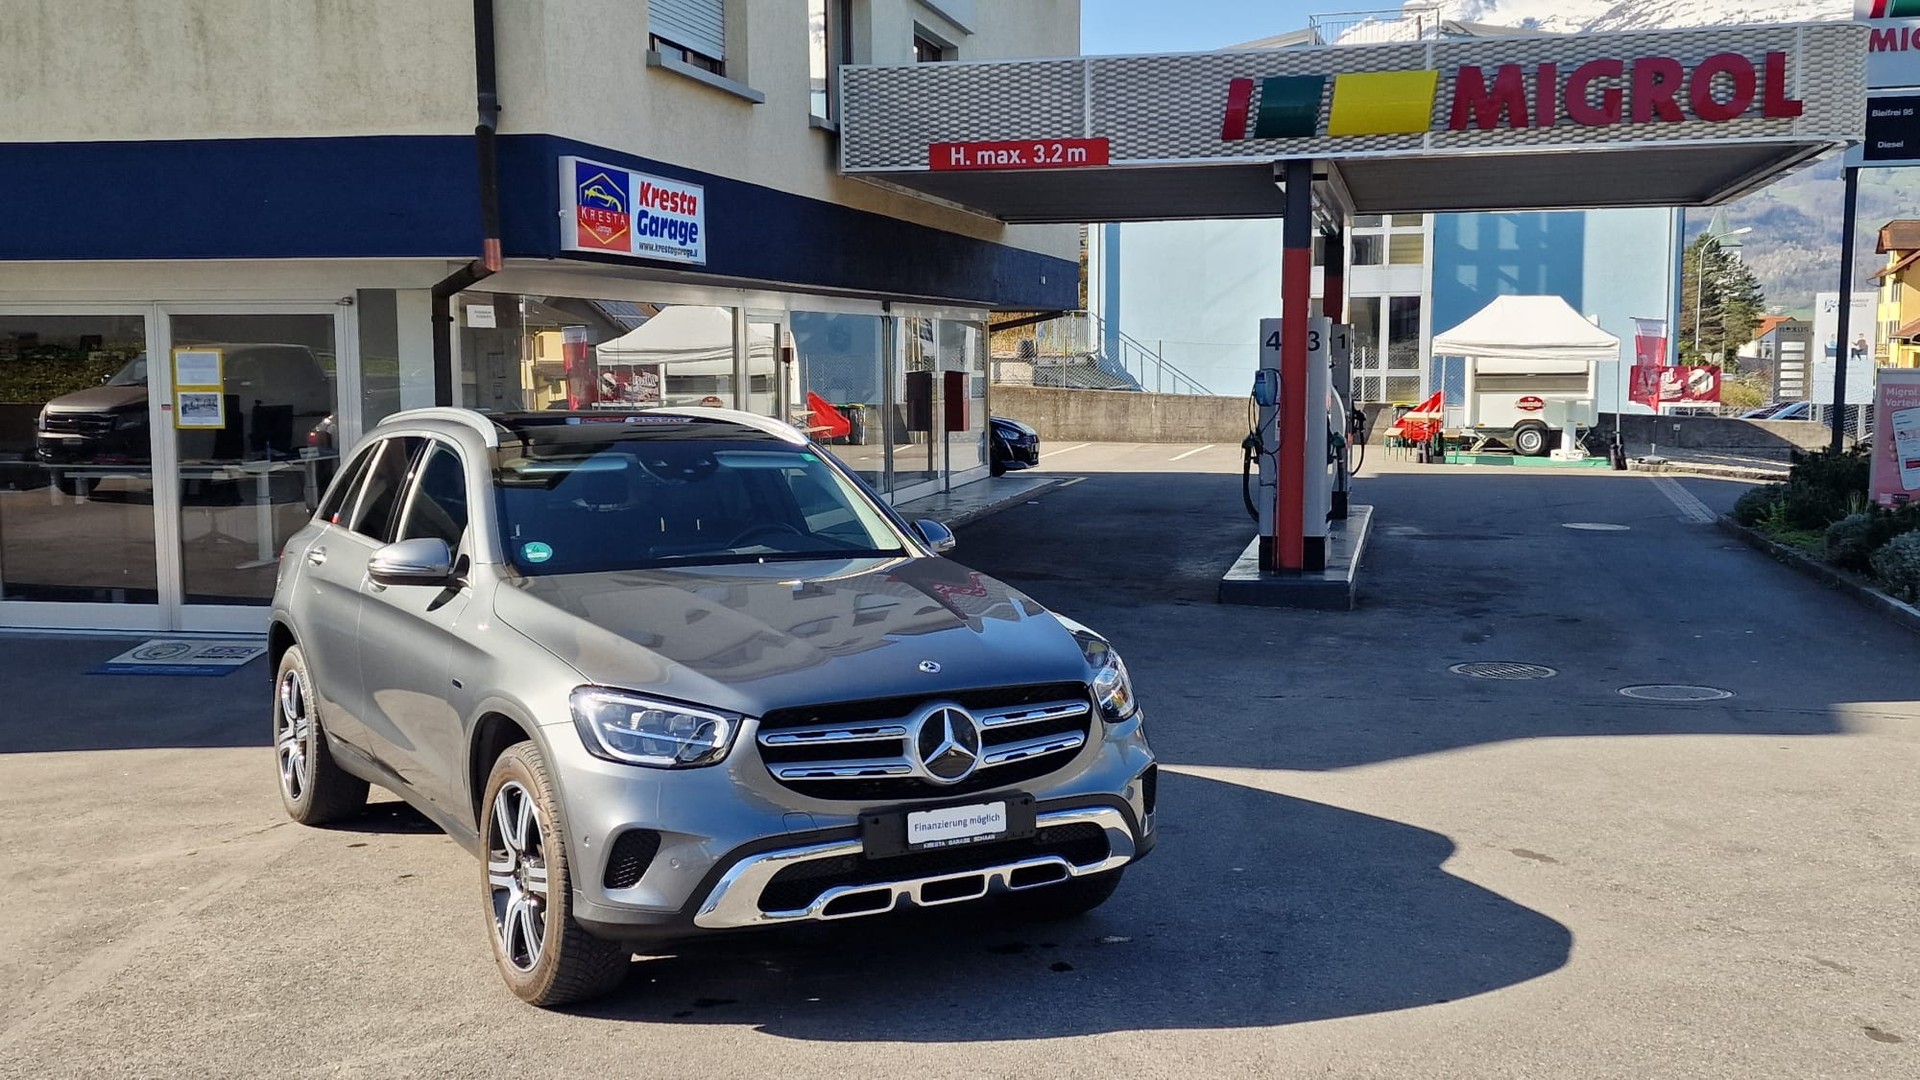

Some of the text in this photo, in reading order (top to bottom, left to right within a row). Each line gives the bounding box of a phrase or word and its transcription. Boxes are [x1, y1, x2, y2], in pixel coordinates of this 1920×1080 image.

[1449, 52, 1803, 131] MIGROL
[1871, 108, 1914, 117] Bleifrei 95
[951, 143, 1087, 166] H. max. 3.2 m
[1877, 140, 1904, 149] Diesel
[638, 181, 698, 216] Kresta
[581, 207, 626, 226] KRESTA
[637, 209, 699, 247] Garage
[1265, 331, 1282, 351] 4
[1308, 331, 1321, 352] 3
[1338, 334, 1346, 349] 1
[1886, 387, 1918, 398] Migrol
[914, 812, 1001, 832] Finanzierung möglich
